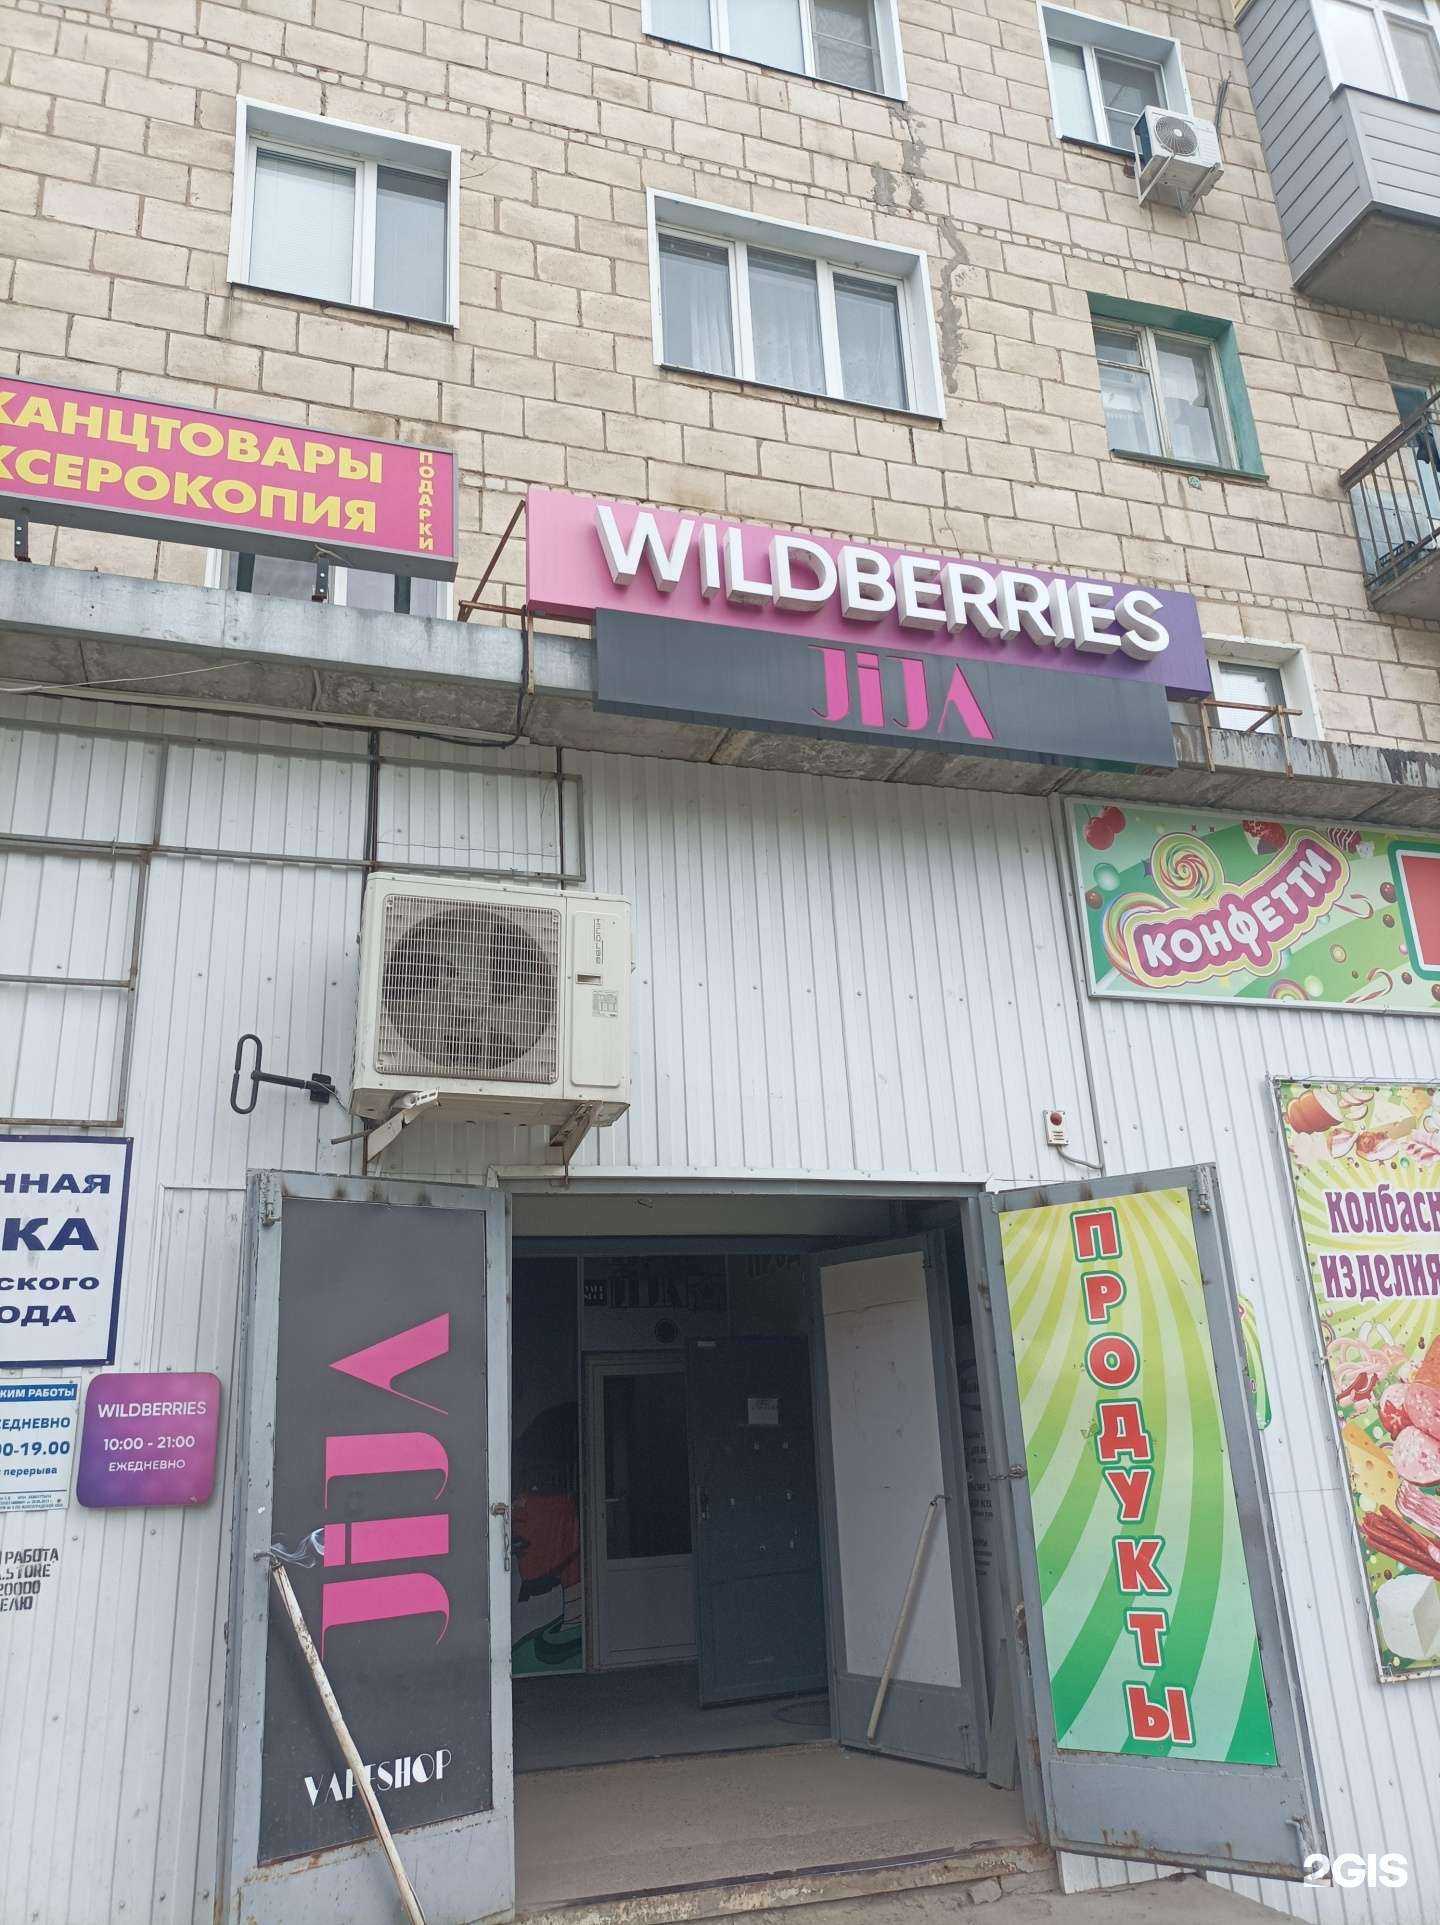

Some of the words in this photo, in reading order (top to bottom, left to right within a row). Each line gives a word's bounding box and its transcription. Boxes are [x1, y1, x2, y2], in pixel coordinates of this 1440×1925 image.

[416, 451, 435, 552] ПОДАРКИ
[597, 504, 1170, 662] WILDBERRIES
[1142, 848, 1332, 968] КОНФЕТТИ
[2, 1217, 99, 1251] КА
[28, 1387, 75, 1398] РАБОТЫ
[97, 1401, 207, 1418] WILDBERRIES
[0, 1440, 70, 1456] 0-19.00
[103, 1437, 144, 1451] 10:00
[157, 1435, 195, 1449] 21:00
[3, 1466, 57, 1477] перерыва
[109, 1459, 186, 1472] ЕЖЕДНЕВНО
[1071, 1209, 1195, 1744] ПРОДУКТЫ
[4, 1547, 59, 1564] РАБОТА
